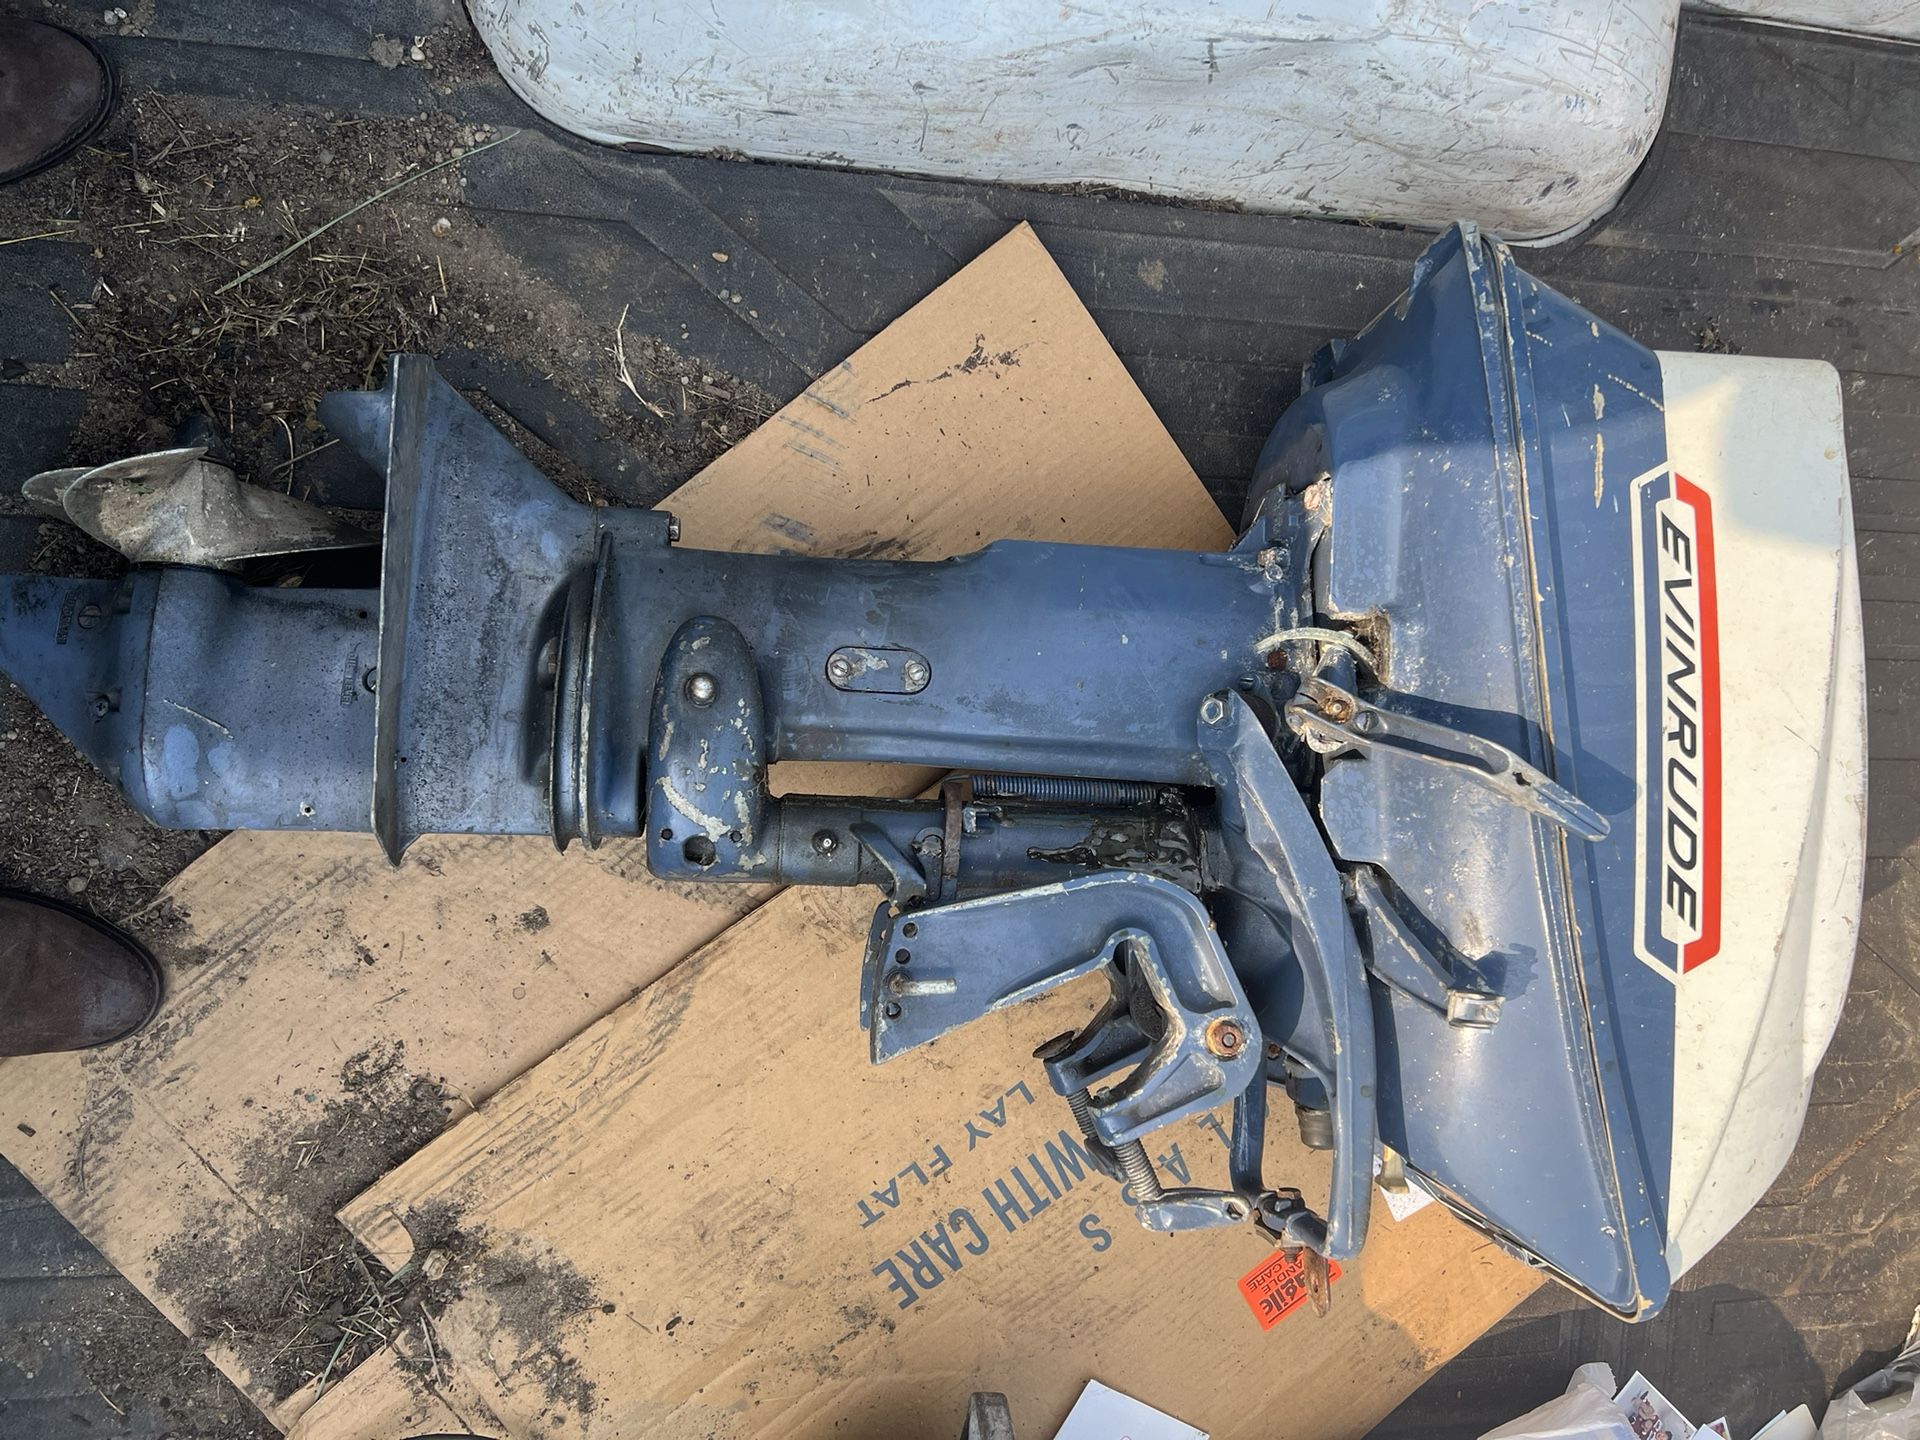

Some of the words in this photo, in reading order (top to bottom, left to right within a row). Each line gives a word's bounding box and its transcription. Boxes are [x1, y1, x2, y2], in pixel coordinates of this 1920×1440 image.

[1661, 512, 1698, 932] EVINRUDE
[963, 1080, 1036, 1152] LAY
[856, 1143, 953, 1230] FLAT
[980, 1129, 1098, 1234] WITH
[871, 1207, 991, 1311] CARE
[1246, 1262, 1283, 1293] CARE
[1261, 1259, 1304, 1295] ANDLE
